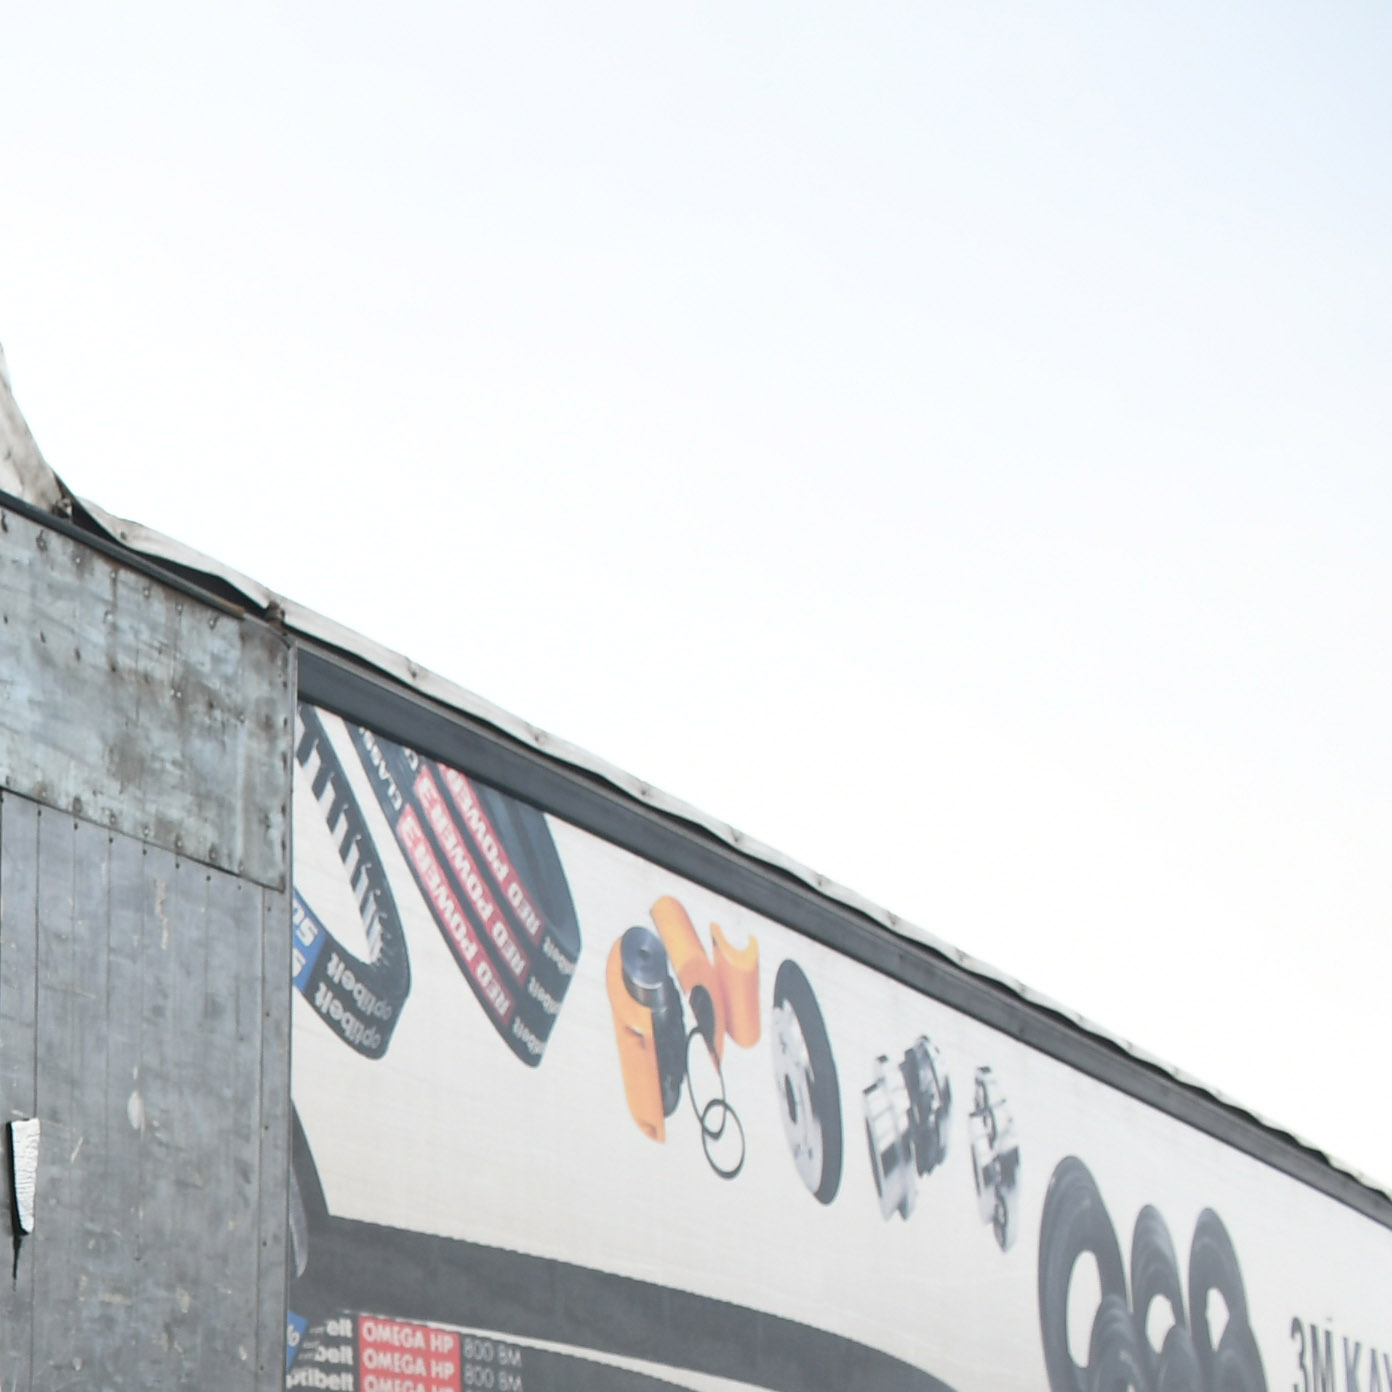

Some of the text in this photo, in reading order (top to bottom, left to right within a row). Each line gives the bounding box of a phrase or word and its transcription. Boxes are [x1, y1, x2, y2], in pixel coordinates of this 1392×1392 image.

[431, 803, 494, 921] POWER
[414, 843, 478, 962] POWER
[491, 921, 526, 976] RED
[327, 952, 392, 1020] optibelt
[475, 961, 510, 1016] RED
[315, 982, 381, 1049] optibelt
[362, 1322, 425, 1349] OMEGA
[430, 1333, 453, 1354] HP
[363, 1348, 426, 1376] OMEGA
[430, 1360, 454, 1380] HP
[286, 1367, 354, 1392] ptibelt
